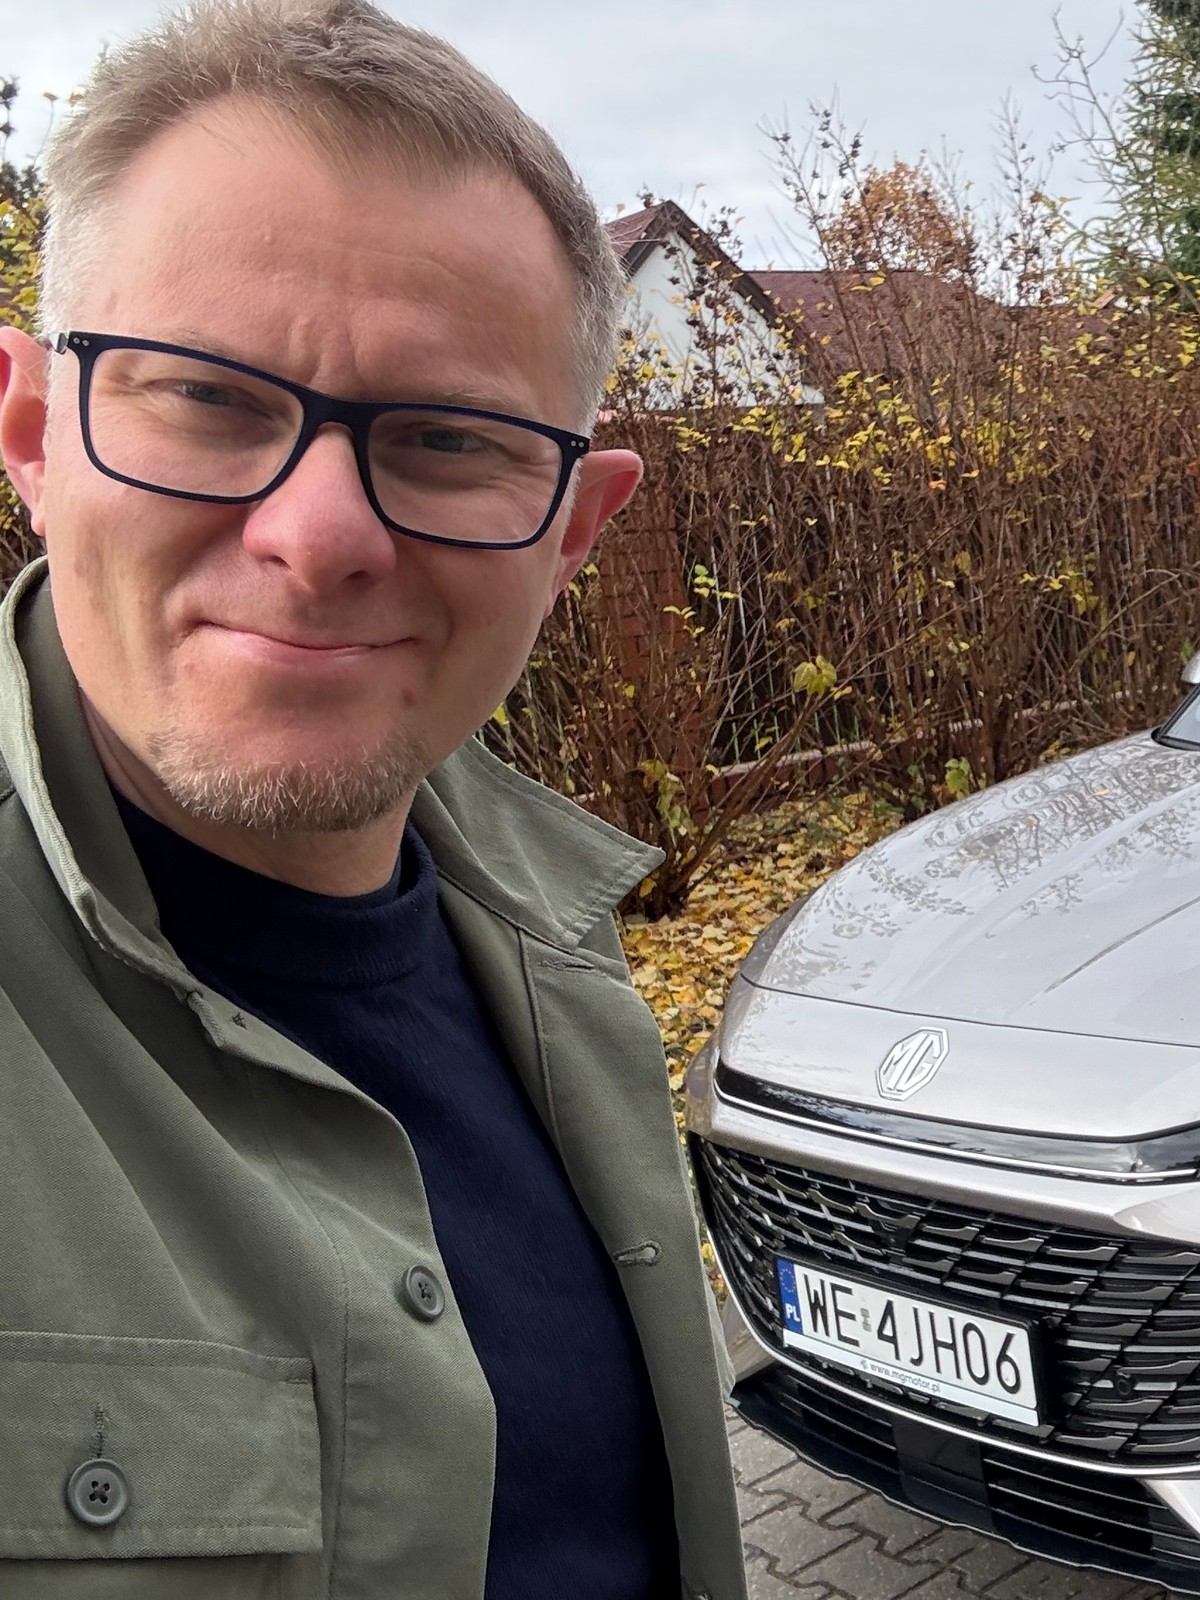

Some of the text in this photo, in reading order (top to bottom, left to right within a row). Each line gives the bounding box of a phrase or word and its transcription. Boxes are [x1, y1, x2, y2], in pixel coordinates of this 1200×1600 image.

[879, 1032, 942, 1093] MG
[785, 1303, 800, 1322] PL
[803, 1273, 1021, 1394] WE 4JH06
